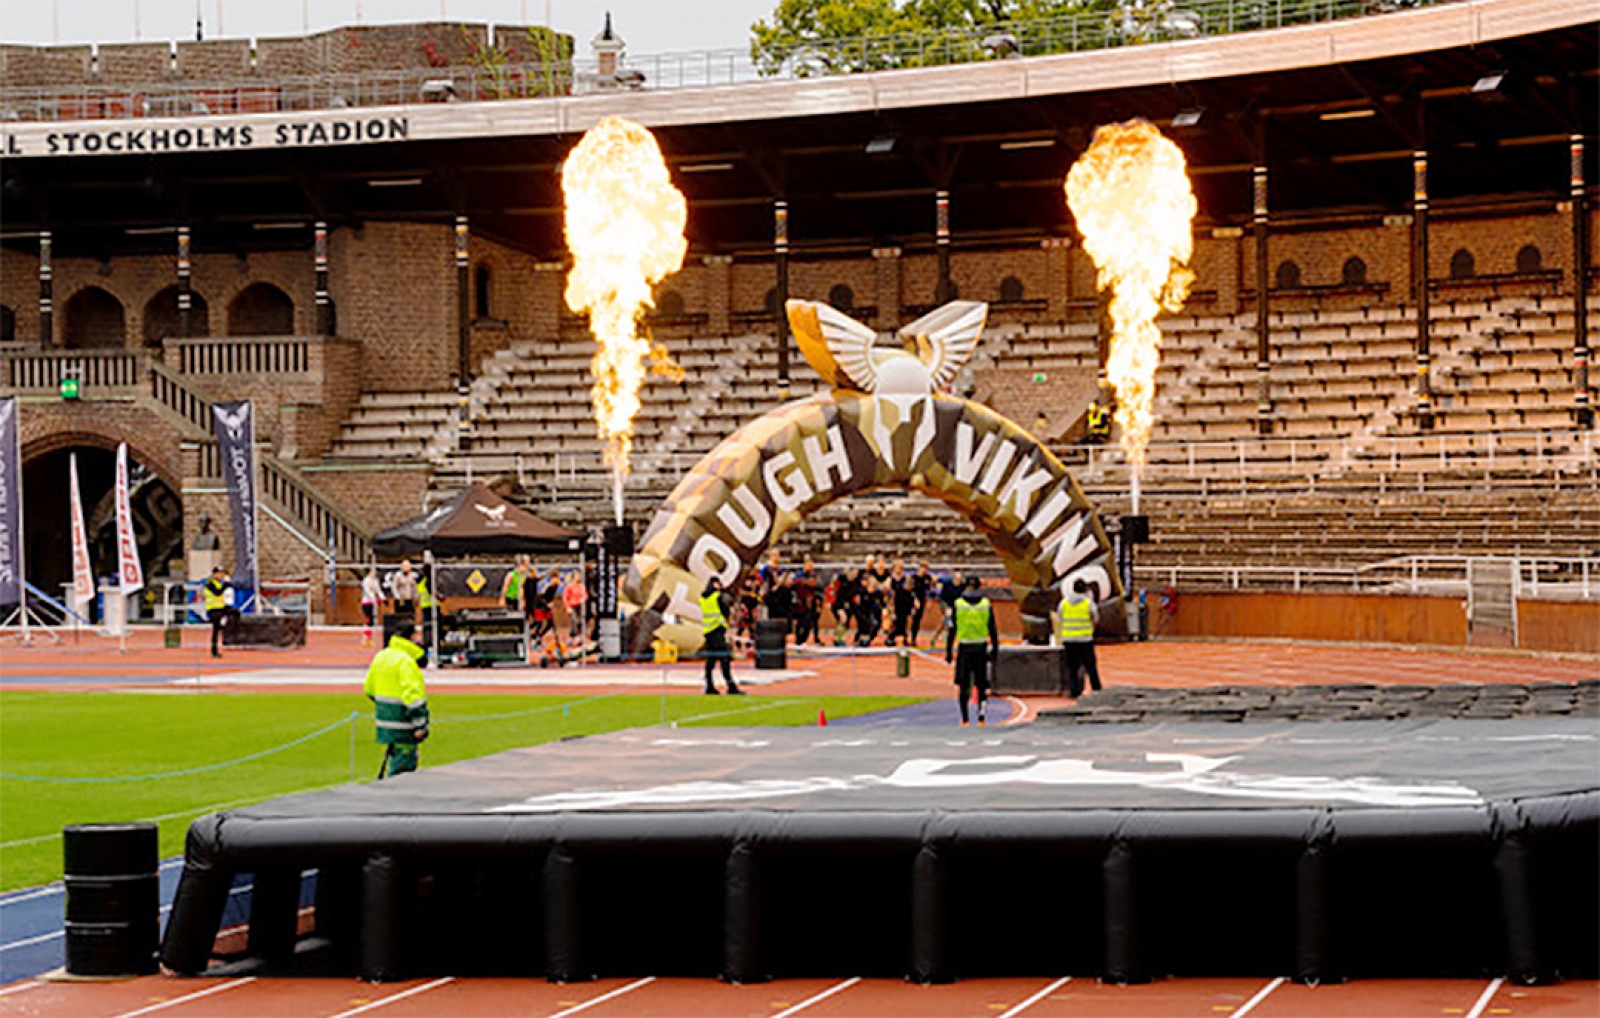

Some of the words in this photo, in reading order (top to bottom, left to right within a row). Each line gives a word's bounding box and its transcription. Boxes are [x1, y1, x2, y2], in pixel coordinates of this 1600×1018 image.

[47, 126, 253, 152] STOCKHOLMS
[276, 118, 408, 144] STADION
[662, 424, 852, 625] TOUGH
[955, 421, 1110, 600] VIKING
